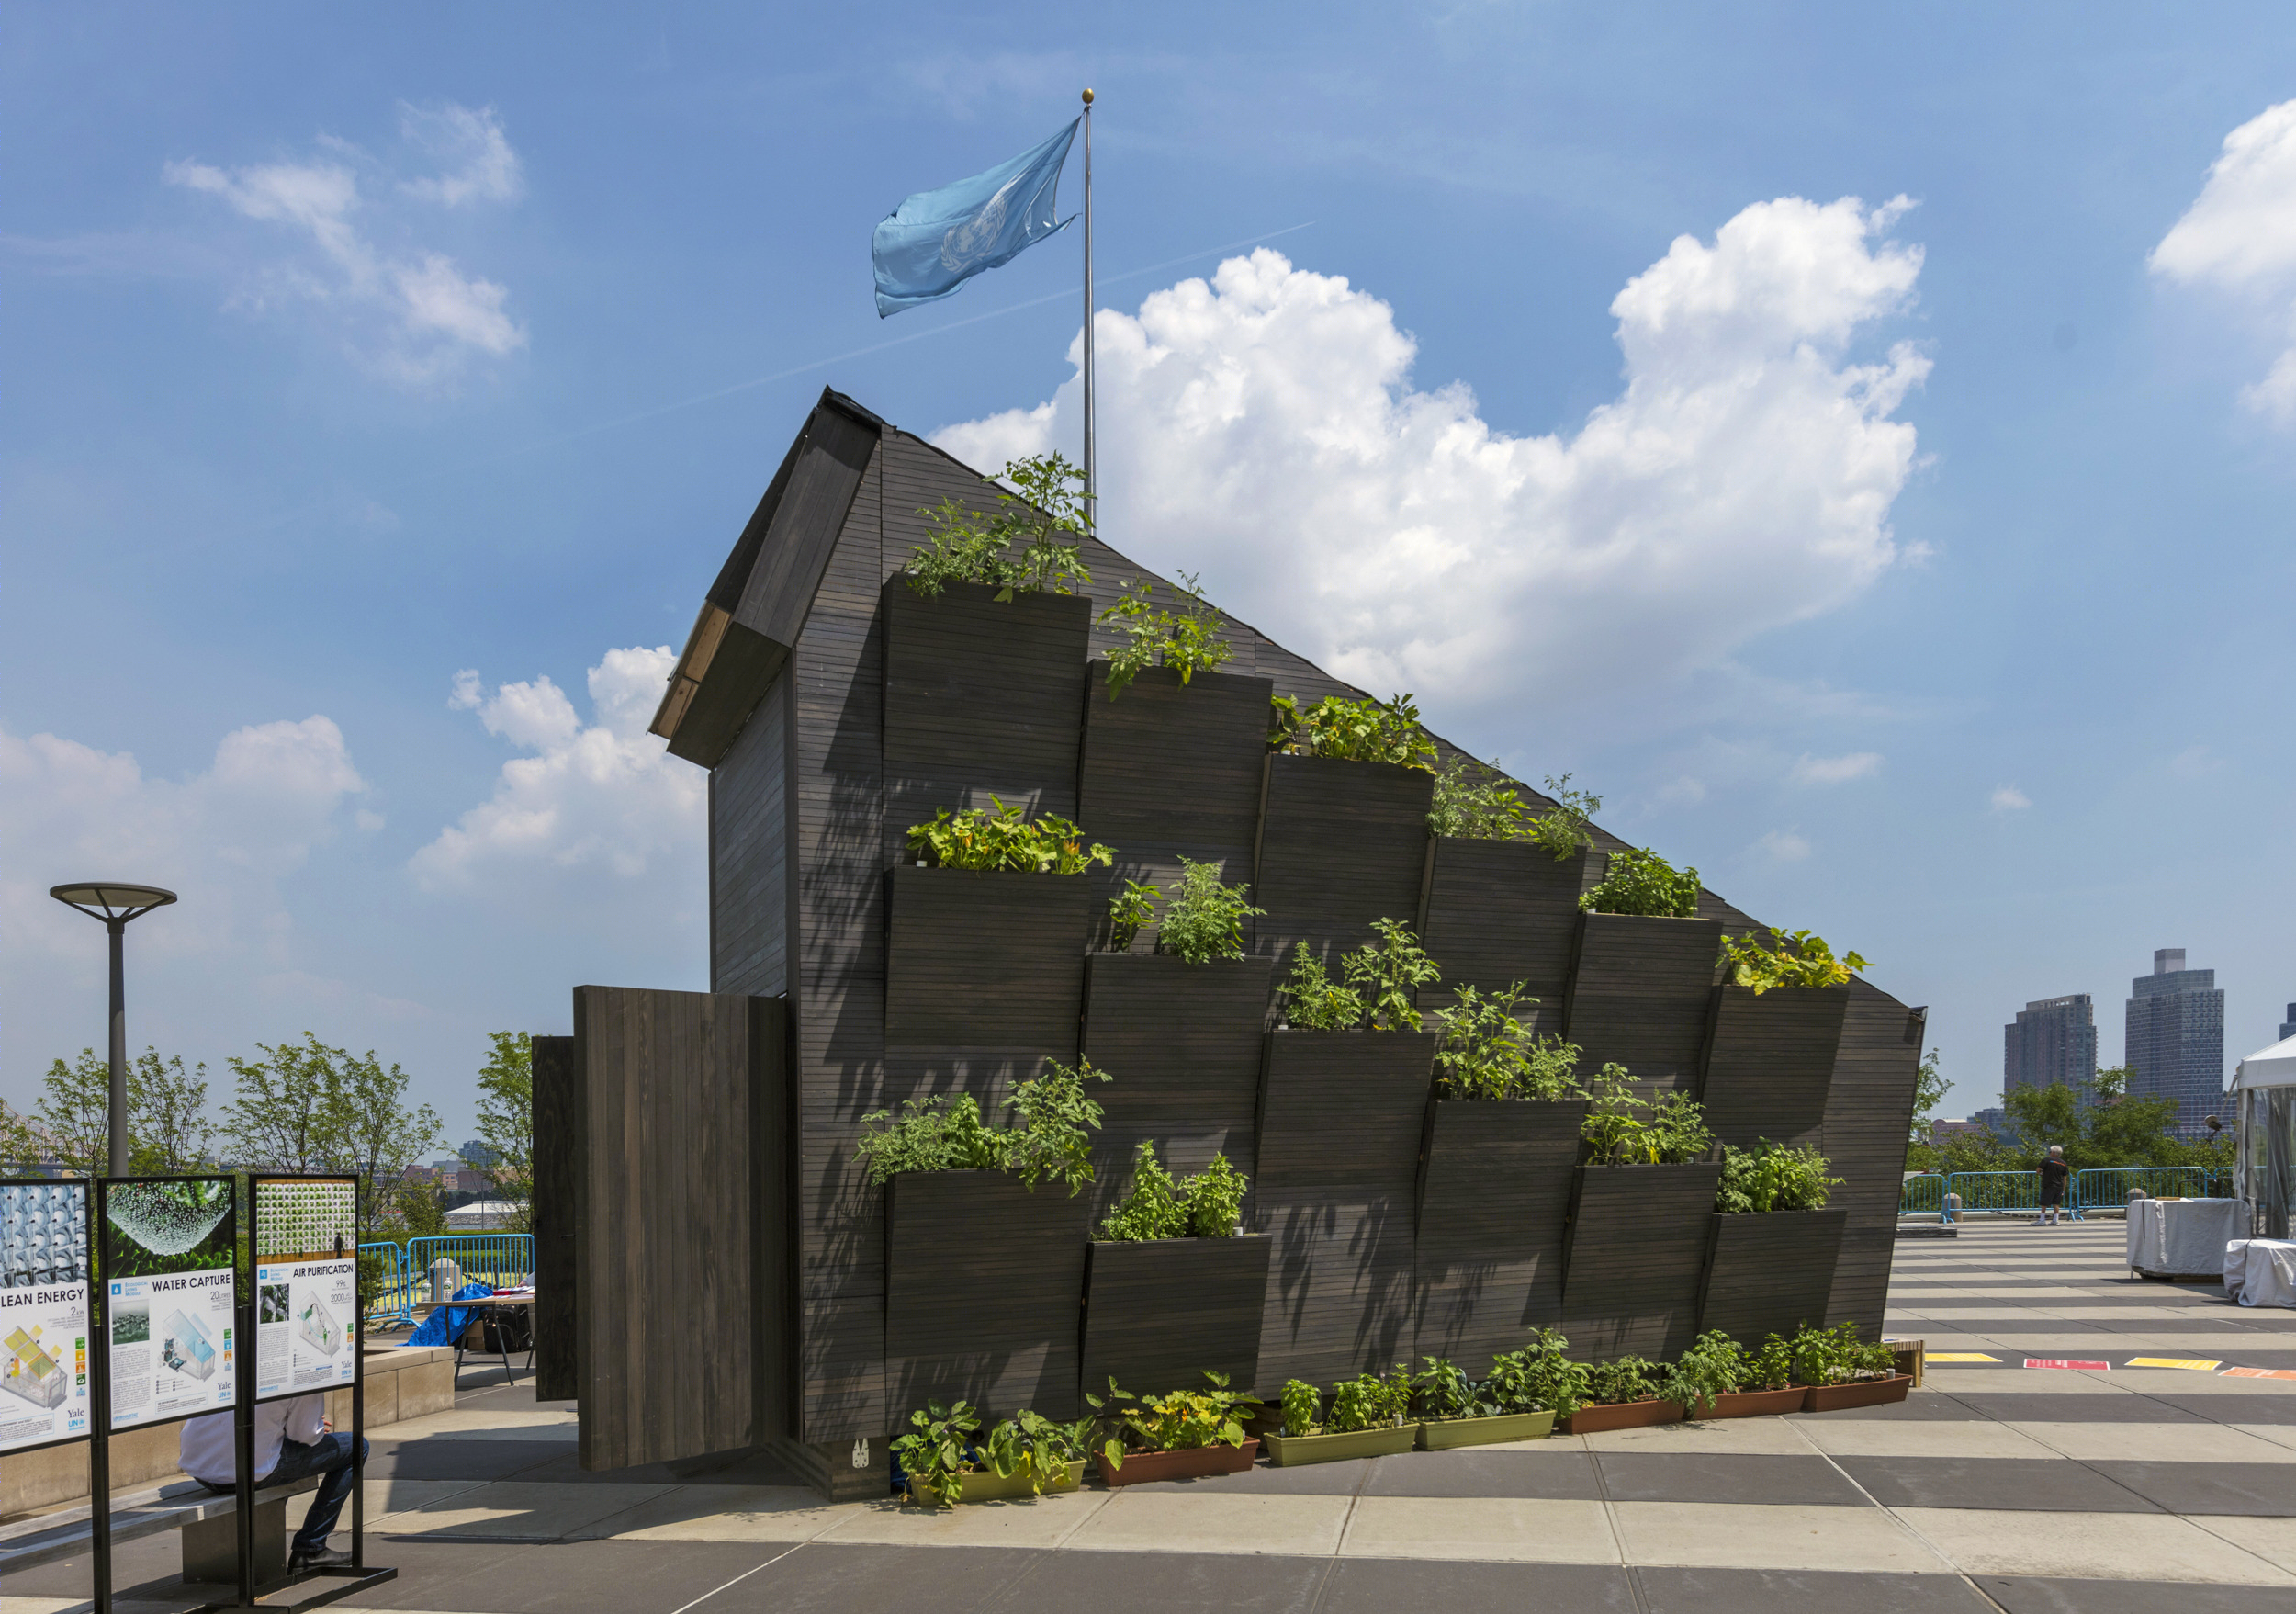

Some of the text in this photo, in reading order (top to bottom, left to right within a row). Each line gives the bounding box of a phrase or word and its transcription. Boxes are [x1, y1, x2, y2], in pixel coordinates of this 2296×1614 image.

[293, 1264, 354, 1278] AIR PURIFICATION
[152, 1274, 231, 1292] WATER CAPTURE
[37, 1288, 84, 1304] ENERGY
[70, 1306, 76, 1316] 2
[218, 1381, 231, 1391] Yale
[67, 1407, 85, 1418] Yale
[68, 1419, 79, 1428] UN
